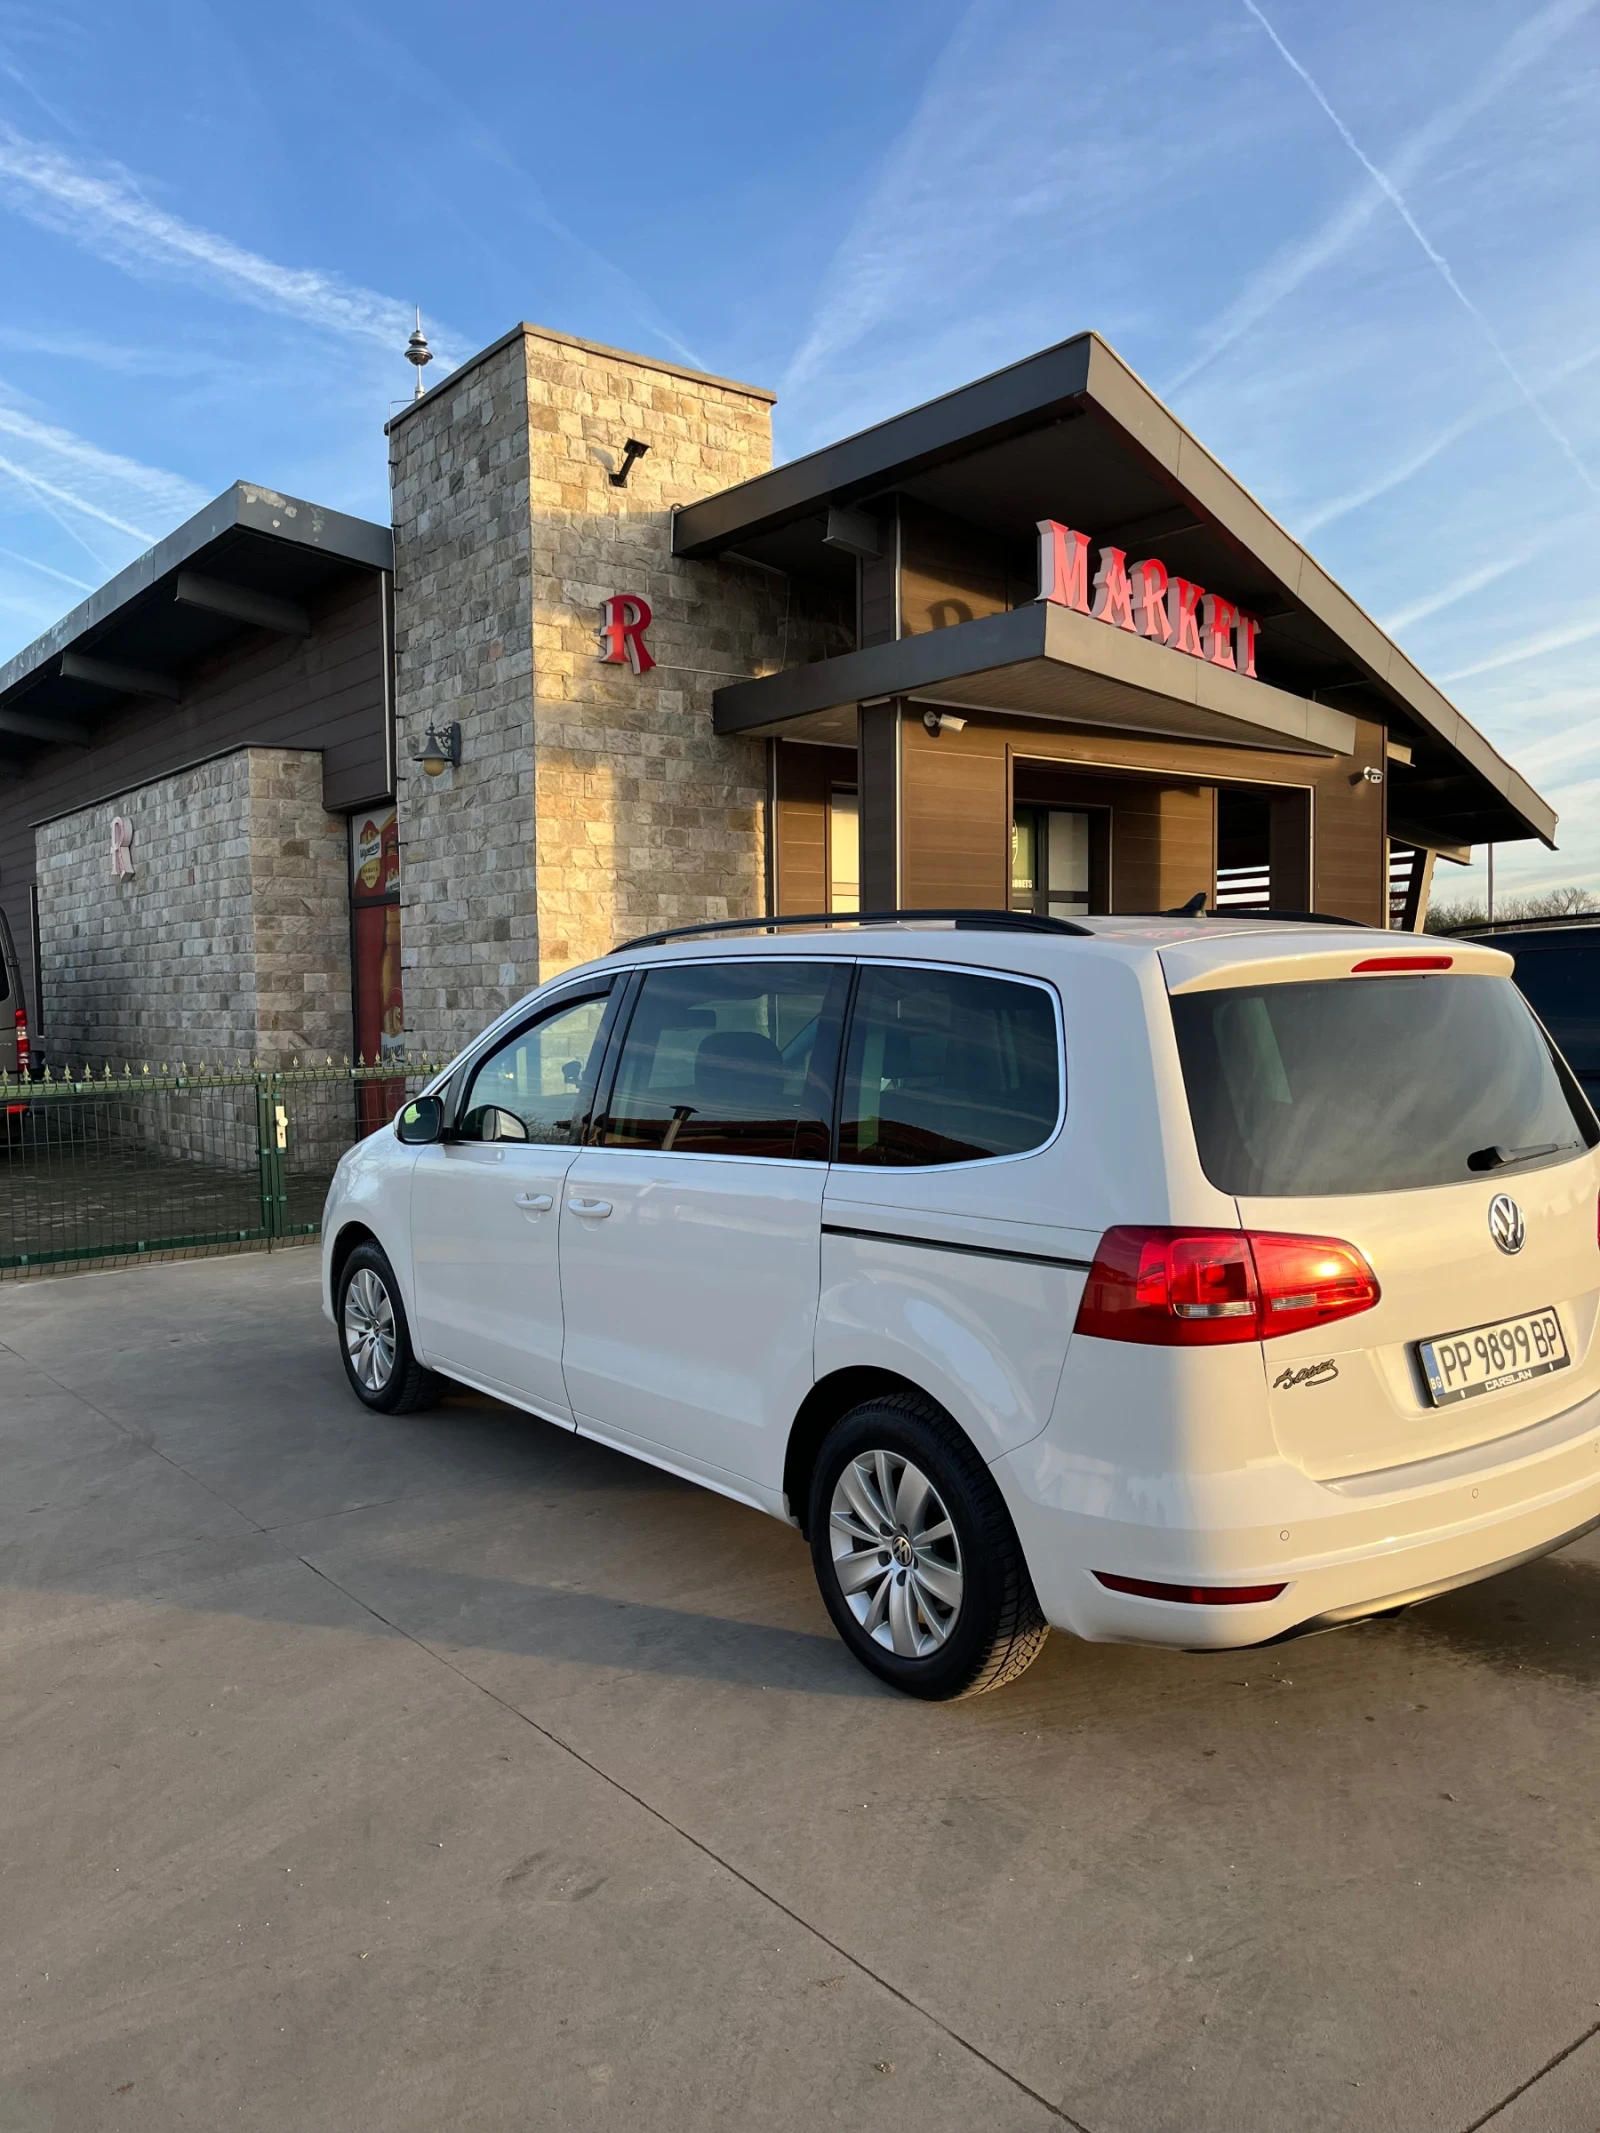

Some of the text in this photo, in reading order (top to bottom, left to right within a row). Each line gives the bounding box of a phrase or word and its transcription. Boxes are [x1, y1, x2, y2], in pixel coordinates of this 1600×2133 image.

[1034, 519, 1262, 679] MARKET
[600, 594, 657, 676] R
[1430, 1376, 1443, 1390] BG
[1438, 1317, 1557, 1387] PP 9899 BP
[1484, 1369, 1533, 1391] CARSLAN
